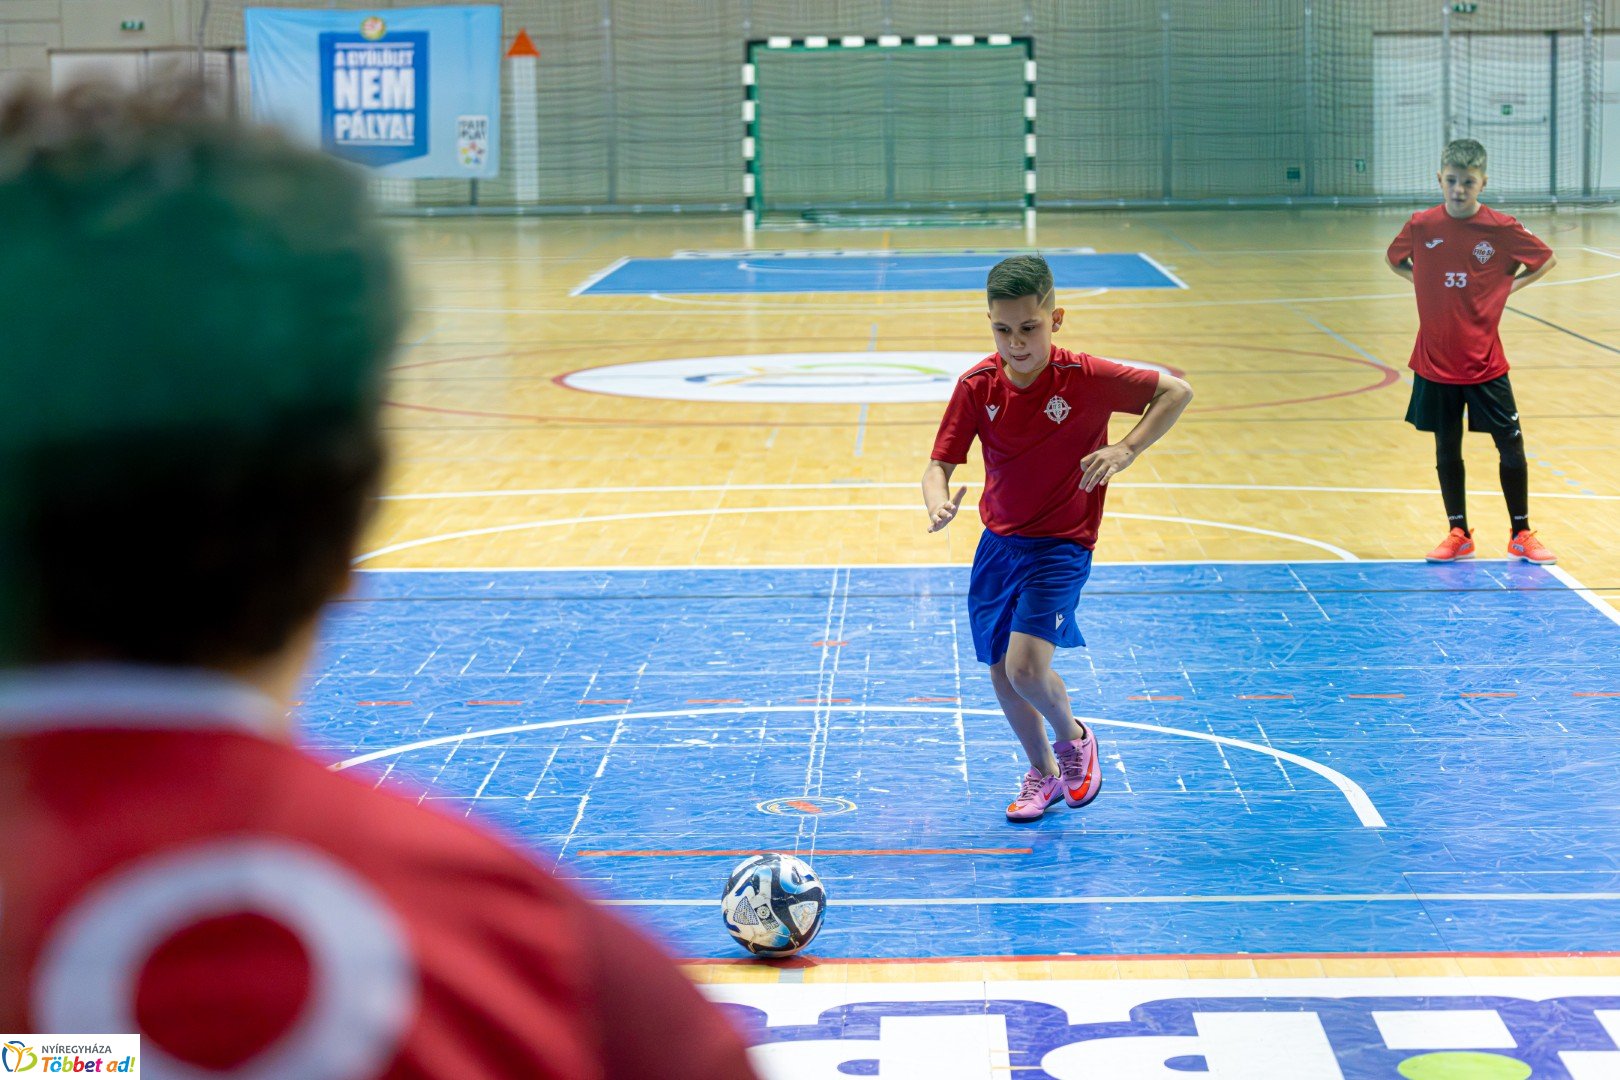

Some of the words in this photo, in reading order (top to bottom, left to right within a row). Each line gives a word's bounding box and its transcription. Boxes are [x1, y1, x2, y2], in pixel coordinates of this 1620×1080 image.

[334, 51, 345, 67] A
[334, 68, 415, 110] NEM
[334, 109, 415, 140] PÁLYA!
[1444, 272, 1467, 288] 33
